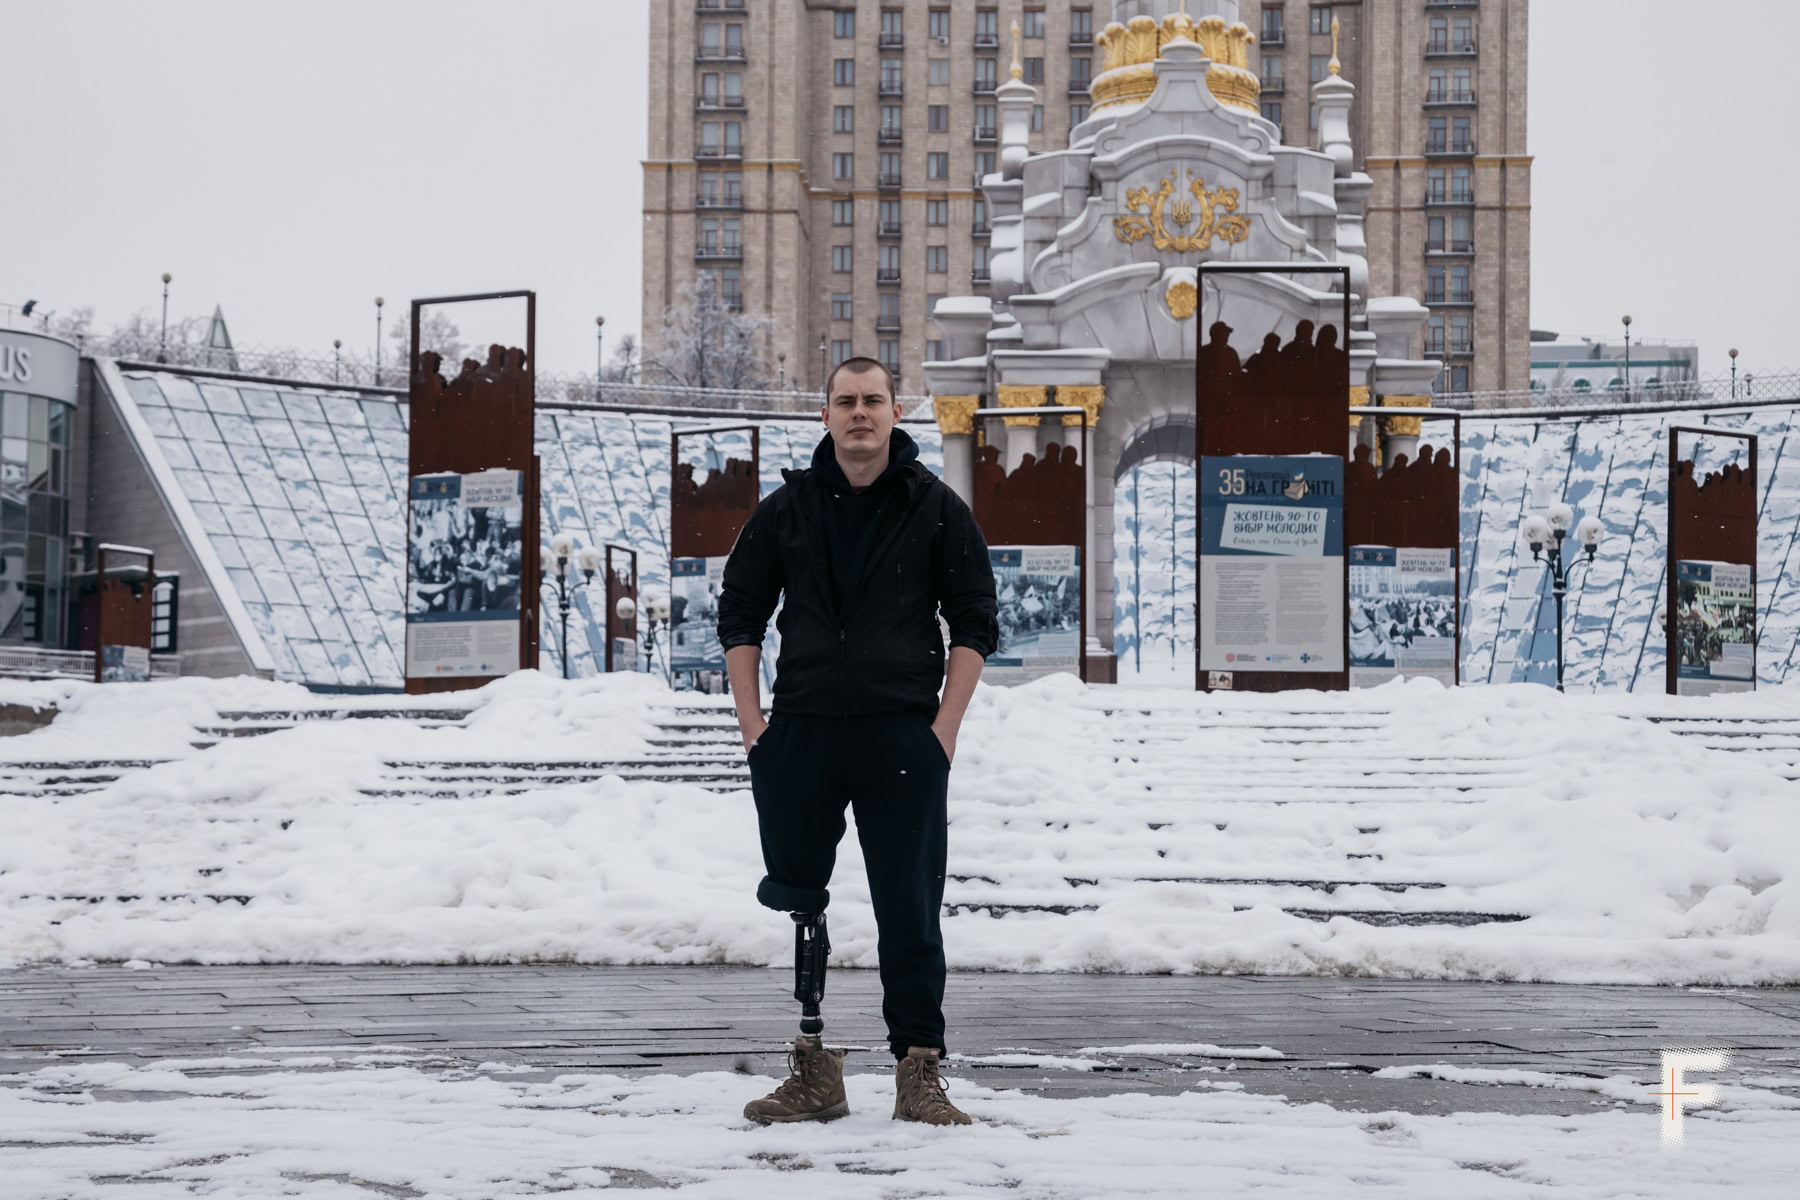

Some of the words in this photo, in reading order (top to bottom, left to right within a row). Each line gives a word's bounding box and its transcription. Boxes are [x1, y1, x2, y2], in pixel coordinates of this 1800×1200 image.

[1219, 468, 1245, 495] 35
[1246, 481, 1267, 495] НА
[1233, 510, 1284, 522] ЖОВТЕНЬ
[1234, 523, 1263, 533] ВИБІР
[1266, 523, 1319, 535] МОЛОДИХ
